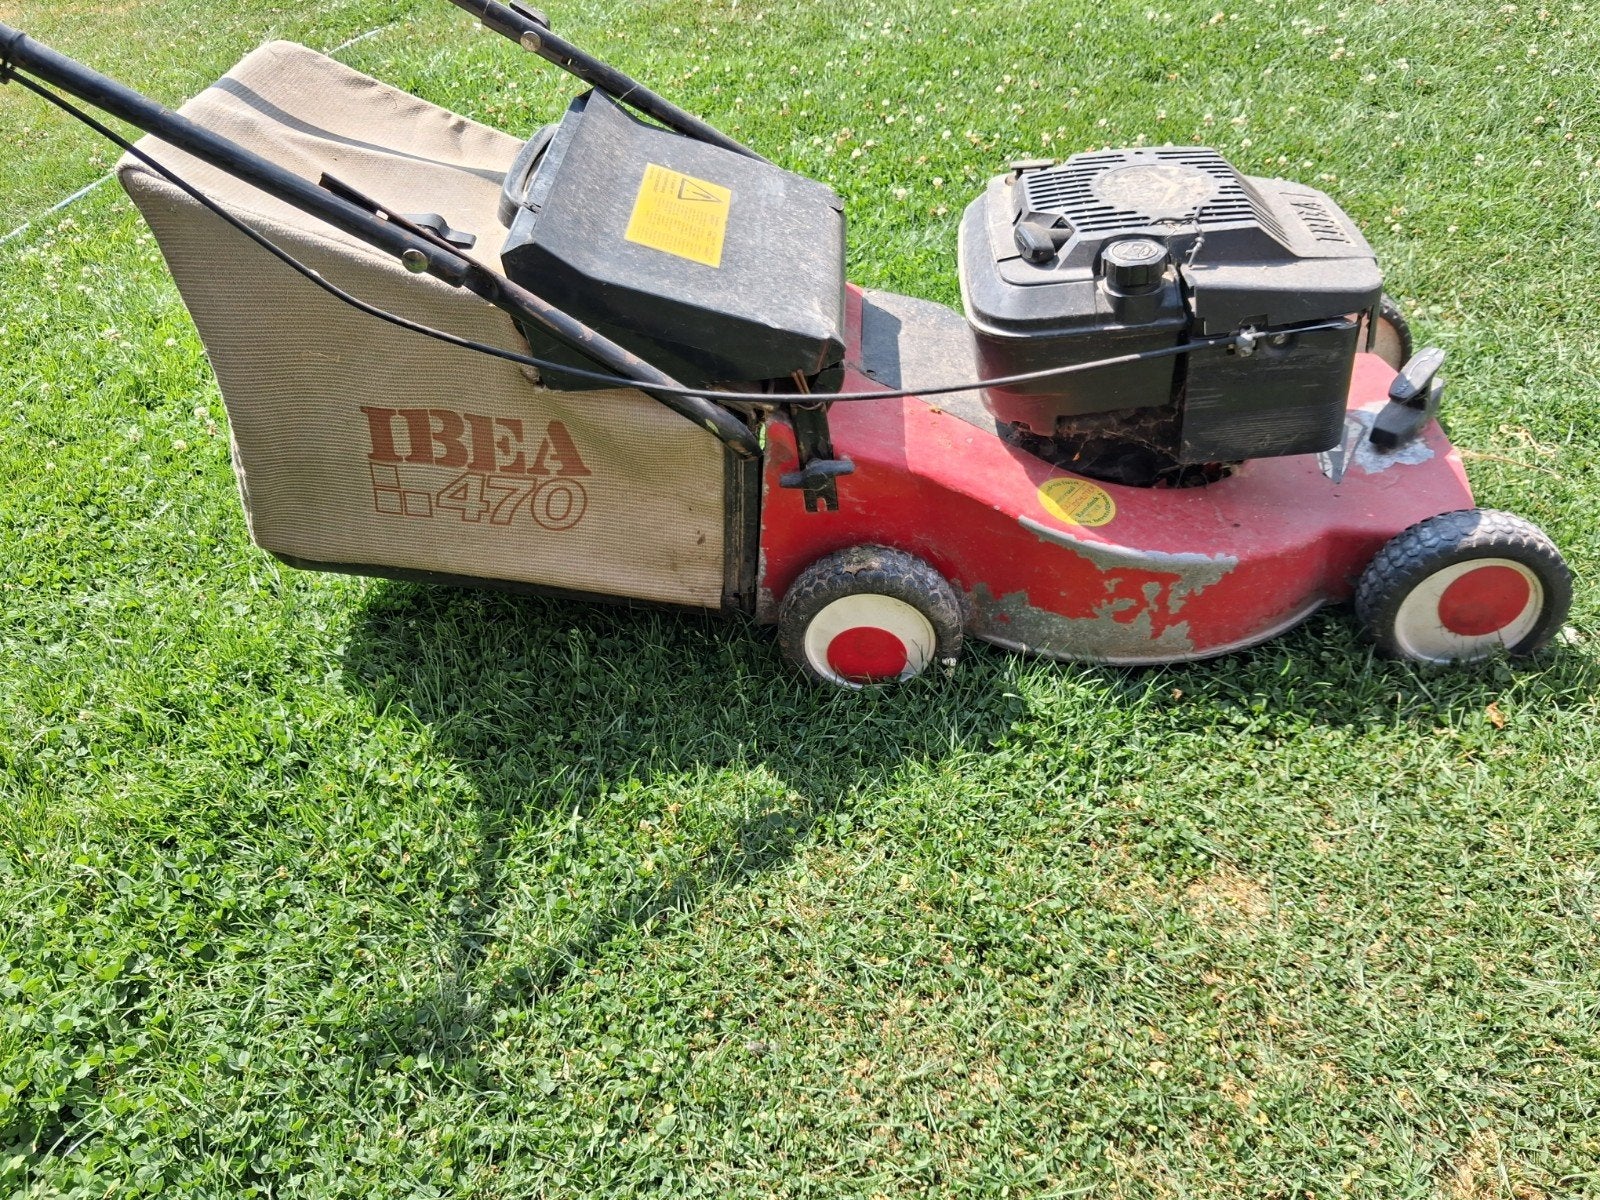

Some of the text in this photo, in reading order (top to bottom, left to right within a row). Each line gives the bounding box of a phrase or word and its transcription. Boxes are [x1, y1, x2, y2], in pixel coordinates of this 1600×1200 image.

[1290, 202, 1351, 244] IBEA
[359, 405, 592, 476] IBEA
[436, 472, 588, 531] 470
